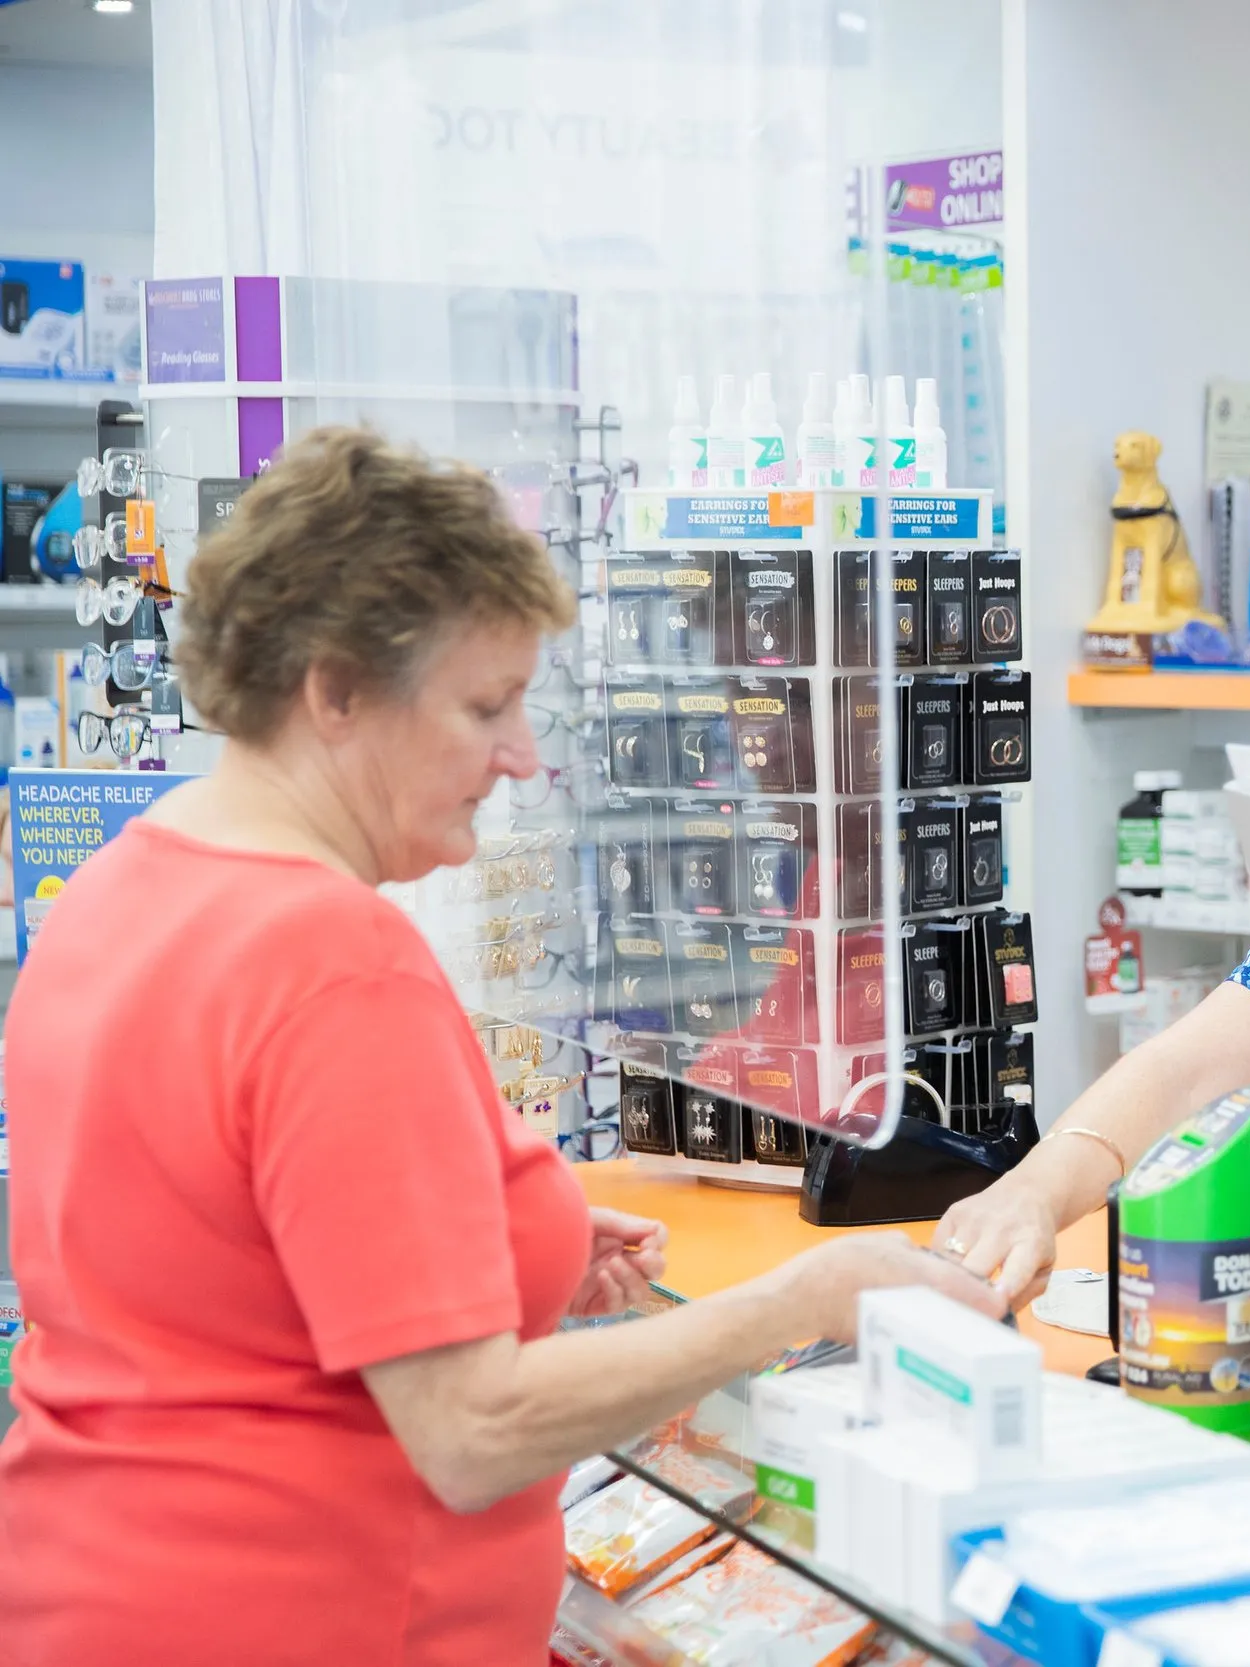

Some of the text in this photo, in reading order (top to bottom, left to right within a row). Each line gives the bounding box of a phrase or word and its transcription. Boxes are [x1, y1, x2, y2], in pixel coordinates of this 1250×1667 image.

[948, 154, 1003, 190] SHOP
[940, 190, 1003, 225] ONLIN
[161, 351, 219, 366] Reading Glasses
[690, 500, 749, 511] EARRINGS
[936, 500, 956, 511] FOR
[688, 513, 746, 524] SENSITIVE
[934, 514, 958, 525] EARS
[669, 571, 706, 584] SENSATION
[751, 573, 789, 585] SENSATION
[933, 577, 964, 591] SLEEPERS
[979, 577, 1016, 590] Just Hoops
[684, 698, 723, 710] SENSATION
[739, 700, 779, 713] SENSATION
[916, 700, 951, 714] SLEEPERS
[983, 699, 1024, 713] Just Hoops
[856, 703, 881, 719] SLEEP
[19, 785, 102, 803] HEADACHE
[20, 806, 104, 825] WHEREVER,
[688, 824, 728, 836] SENSATION
[752, 823, 791, 837] SENSATION
[917, 823, 950, 839] SLEEPERS
[969, 821, 981, 834] Just
[20, 828, 103, 845] WHENEVER
[21, 847, 52, 865] YOU
[687, 945, 723, 958] SENSATION
[755, 951, 793, 963] SENSATION
[687, 1069, 728, 1083] SENSATION
[0, 1306, 22, 1319] OFEN
